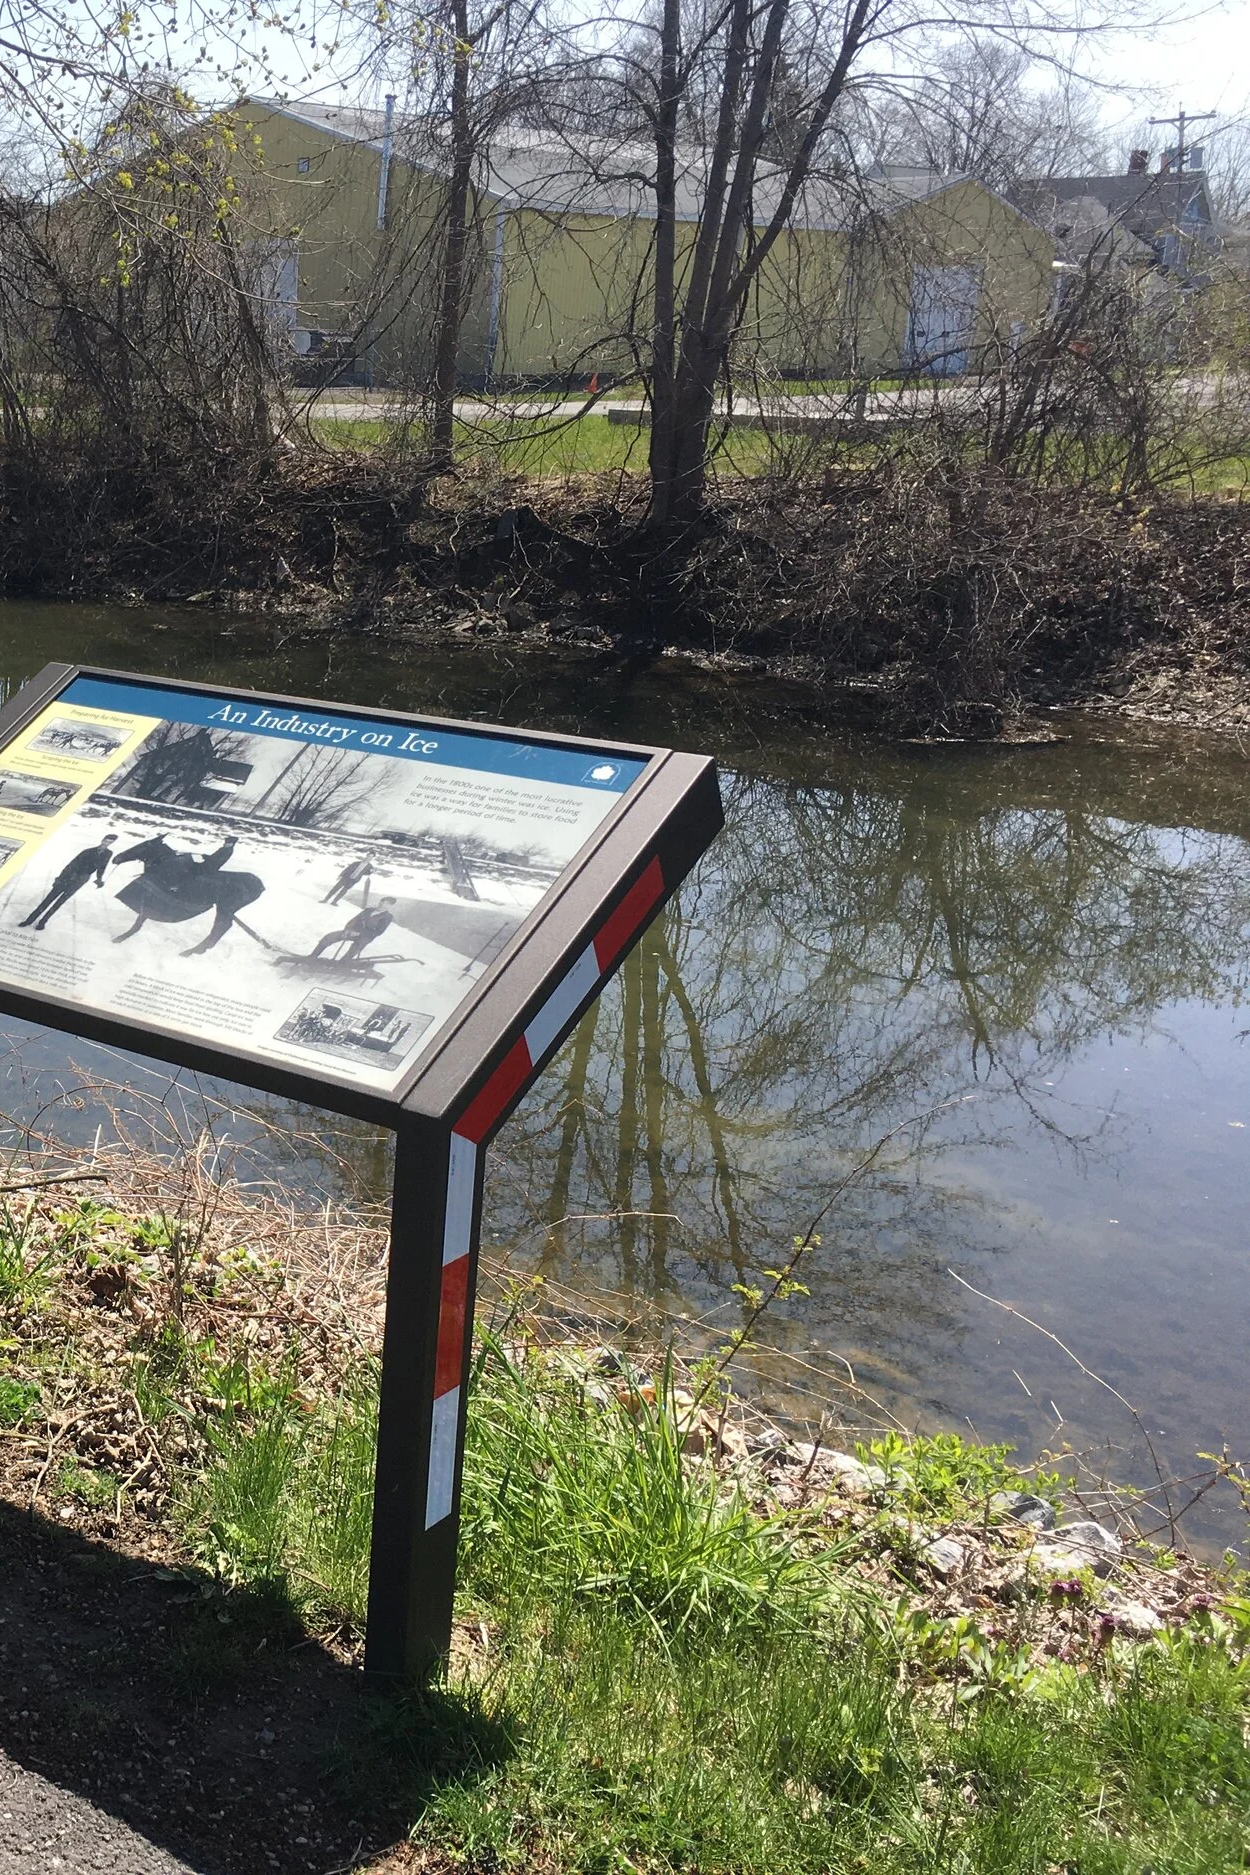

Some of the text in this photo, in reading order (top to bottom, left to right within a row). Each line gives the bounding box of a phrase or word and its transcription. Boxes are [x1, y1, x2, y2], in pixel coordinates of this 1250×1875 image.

[207, 704, 439, 754] An Industry on Ice
[415, 783, 457, 794] businesses
[458, 790, 486, 801] during
[488, 796, 516, 805] winter
[554, 805, 580, 817] Using
[448, 779, 474, 788] 1800s
[504, 788, 519, 796] the
[520, 792, 543, 800] most
[424, 801, 452, 811] longer
[452, 807, 483, 817] period
[468, 800, 482, 808] for
[529, 812, 553, 820] store
[554, 815, 578, 824] food
